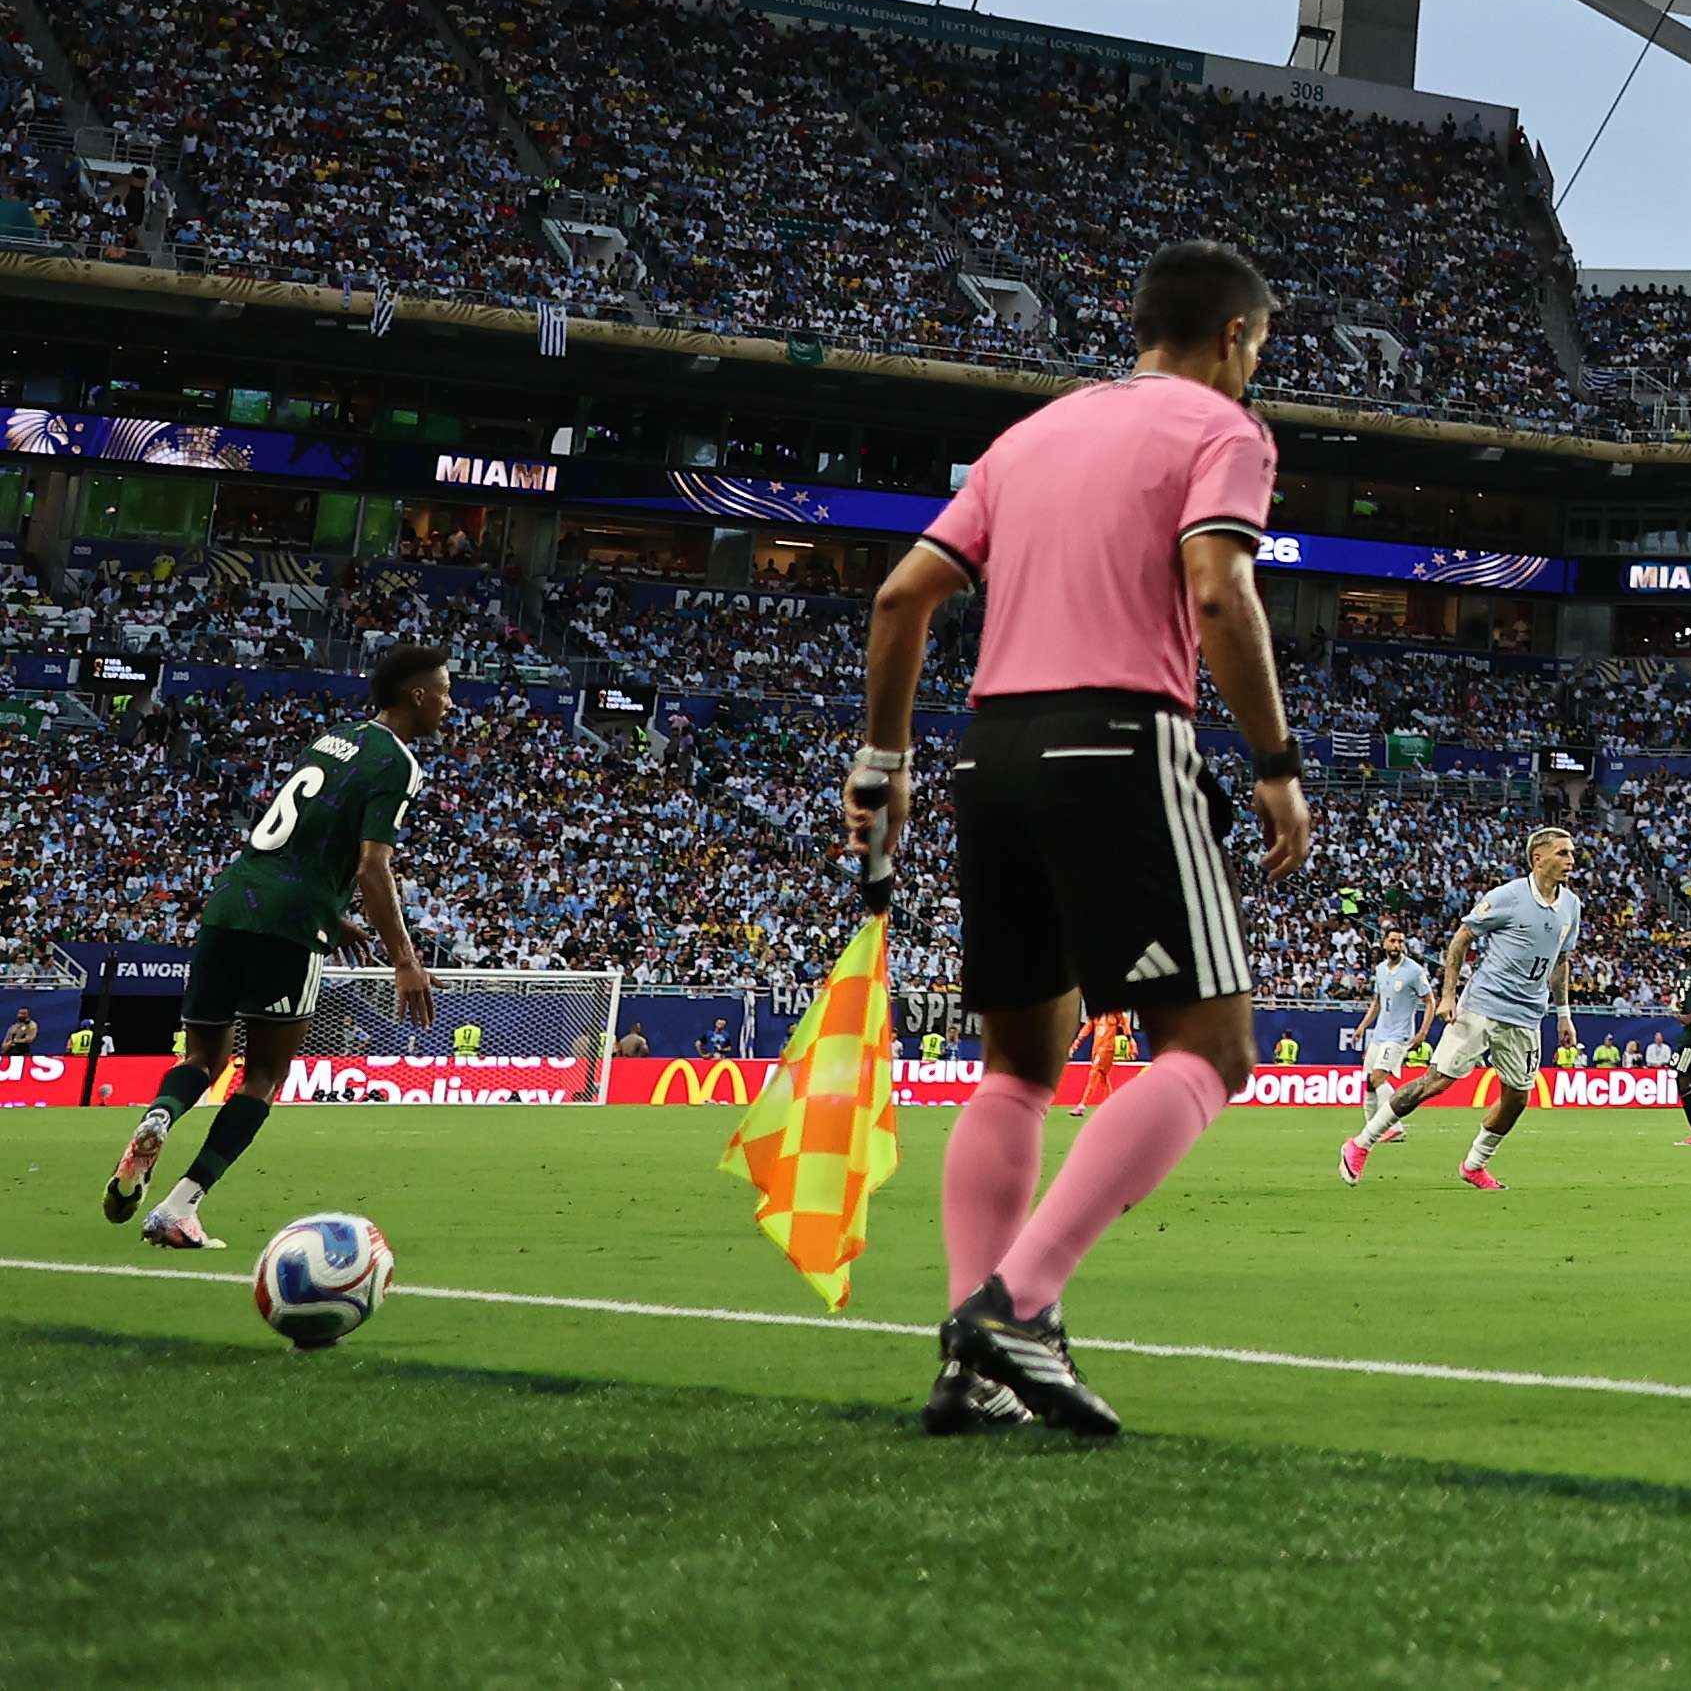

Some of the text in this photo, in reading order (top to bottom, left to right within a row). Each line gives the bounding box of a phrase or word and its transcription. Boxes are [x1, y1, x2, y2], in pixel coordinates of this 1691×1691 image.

[872, 6, 929, 28] BEHAVIOR
[1290, 81, 1324, 102] 308
[435, 454, 558, 492] MIAMI
[1255, 535, 1300, 562] 26
[249, 765, 325, 852] 6
[141, 962, 191, 978] WORL
[1529, 956, 1550, 981] 13
